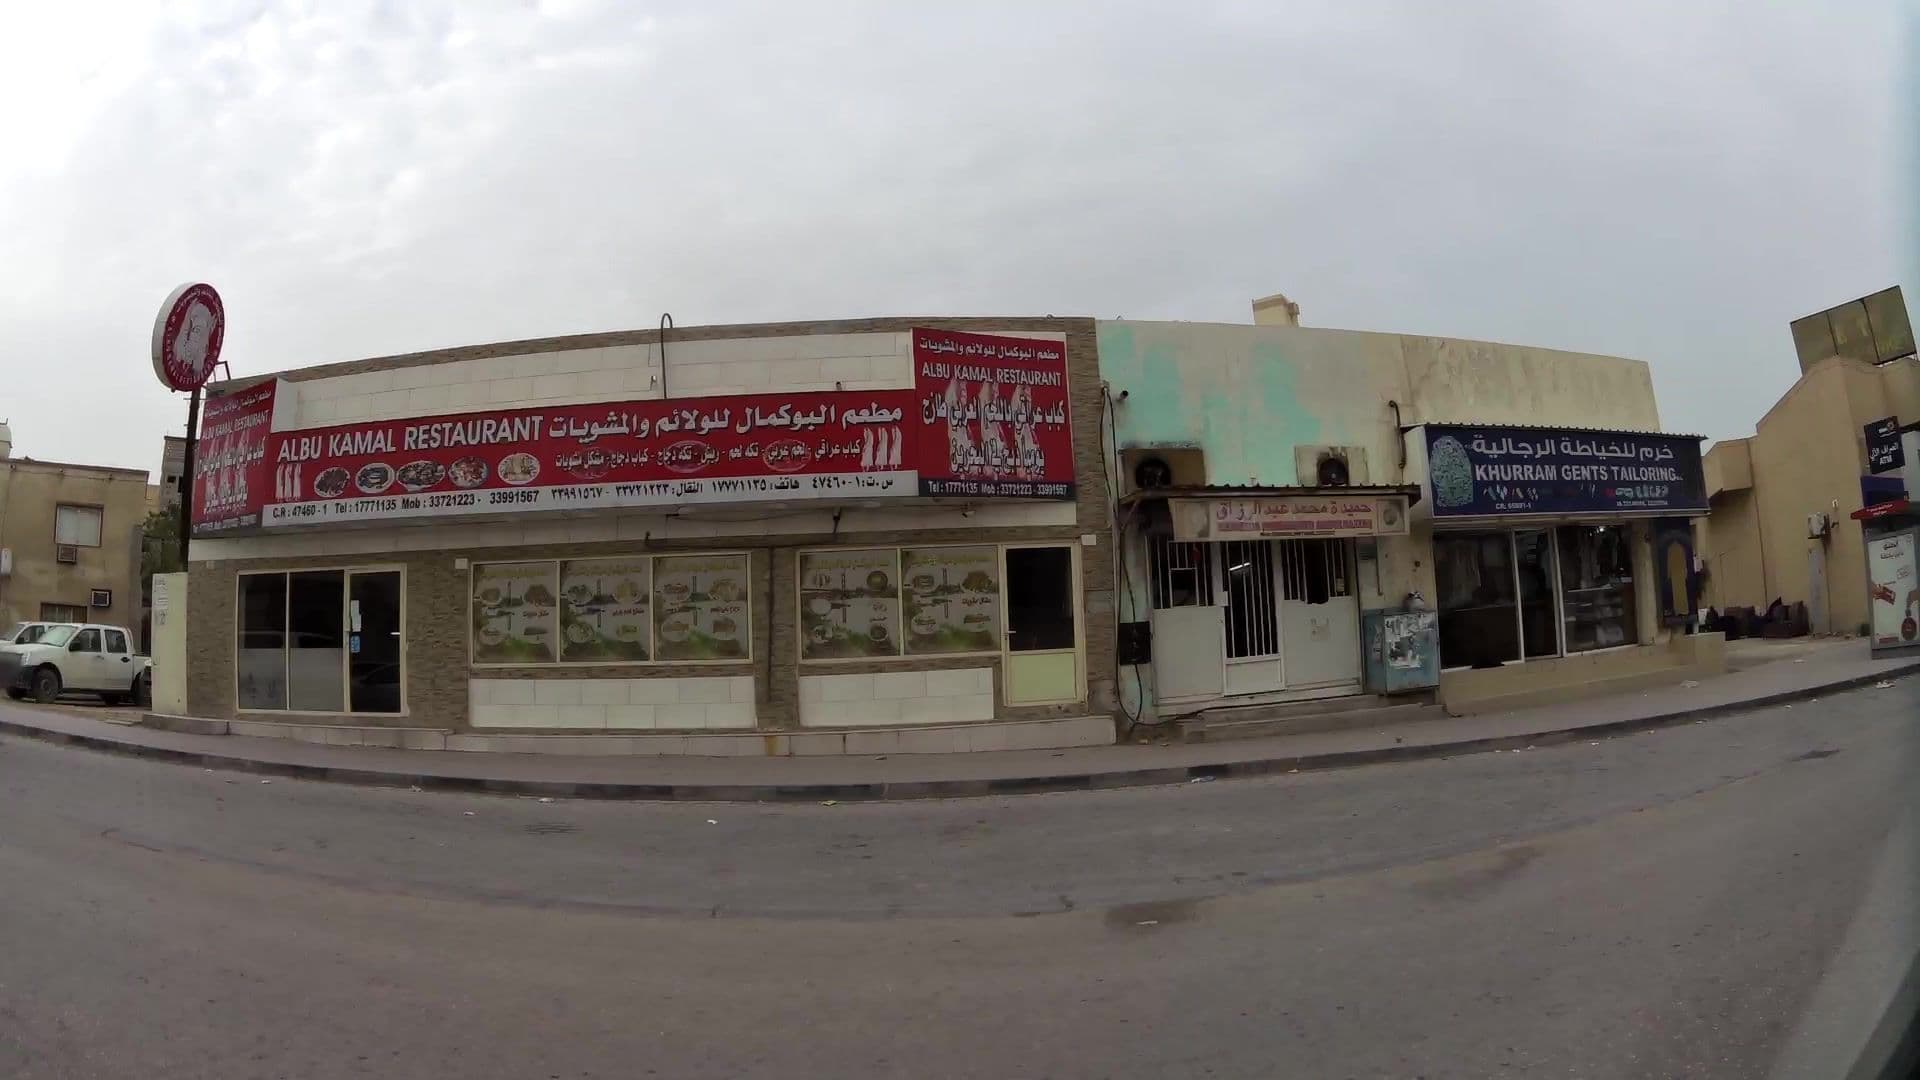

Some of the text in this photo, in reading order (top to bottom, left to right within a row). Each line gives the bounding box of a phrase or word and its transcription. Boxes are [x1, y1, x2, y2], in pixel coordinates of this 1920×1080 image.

[1037, 348, 1059, 362] مطعم
[922, 361, 1062, 387] ALBU KAMAL RESTAURANT
[550, 401, 903, 444] مطعم البوكمال للولائم والمشويات
[277, 435, 322, 463] ALBU
[328, 428, 397, 458] KAMAL
[404, 416, 544, 450] RESTAURANT
[842, 439, 861, 458] كباب
[1472, 434, 1674, 462] خرم للخياطة الرجالية
[1879, 455, 1893, 465] ATM
[1475, 464, 1557, 481] KHURRAM
[1561, 465, 1608, 481] GENTS
[355, 499, 397, 513] 17771135
[429, 493, 475, 507] 33721223
[489, 490, 540, 504] 33991567
